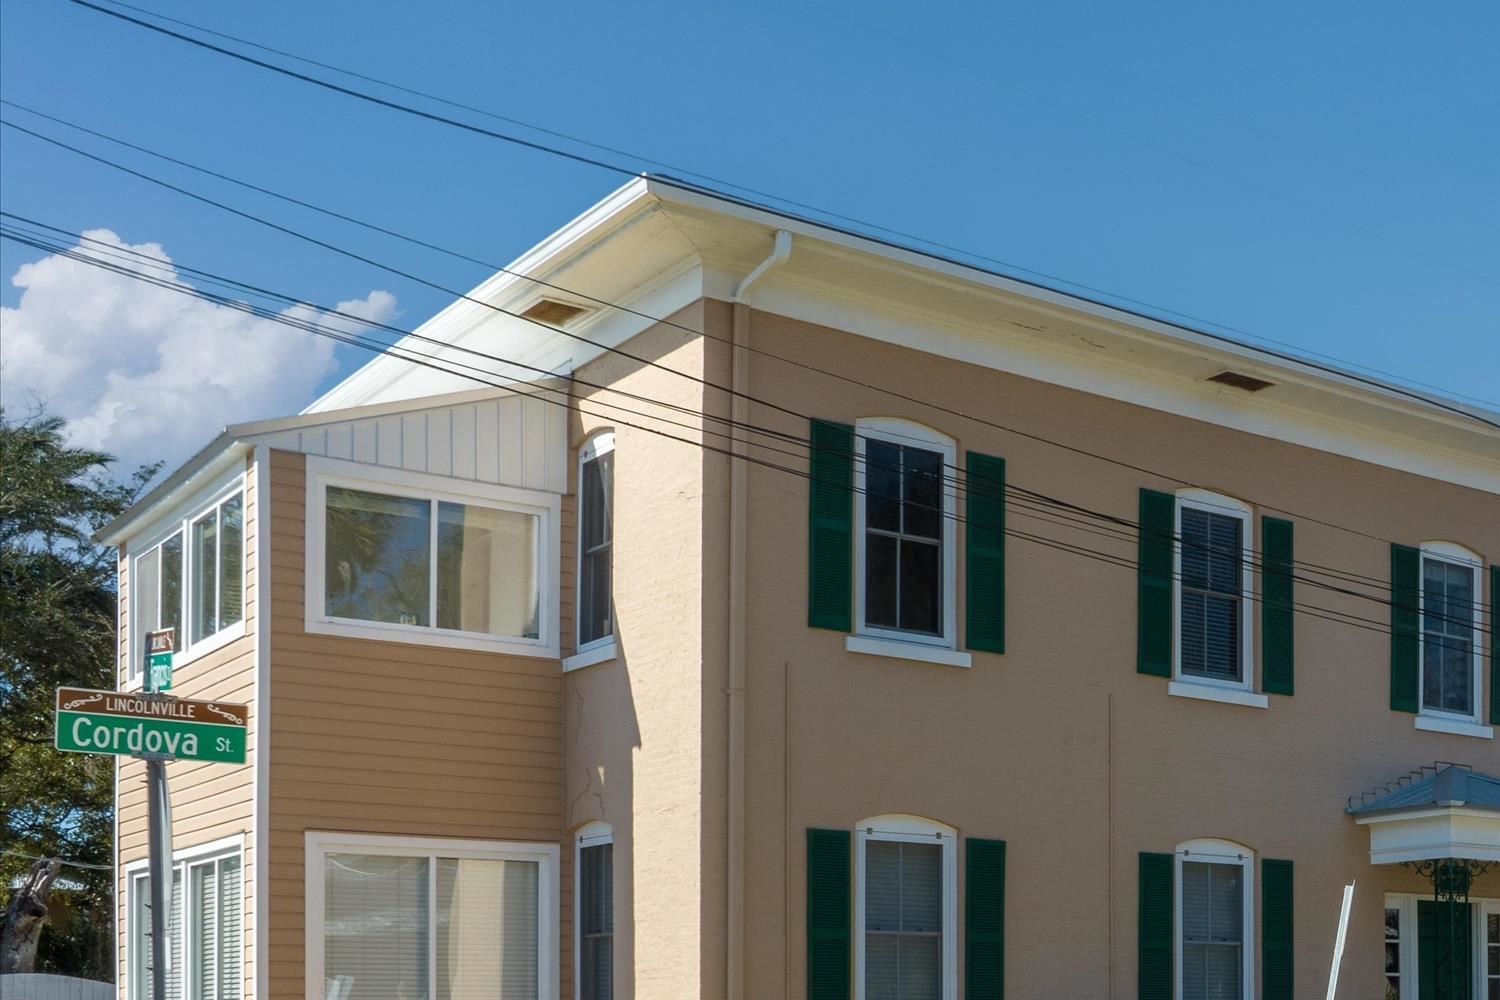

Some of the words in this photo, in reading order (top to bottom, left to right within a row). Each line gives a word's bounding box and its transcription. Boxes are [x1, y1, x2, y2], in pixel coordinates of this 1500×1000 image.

[106, 697, 196, 718] LINCOLNVILLE
[72, 717, 198, 755] Cordova
[215, 736, 235, 753] St.
